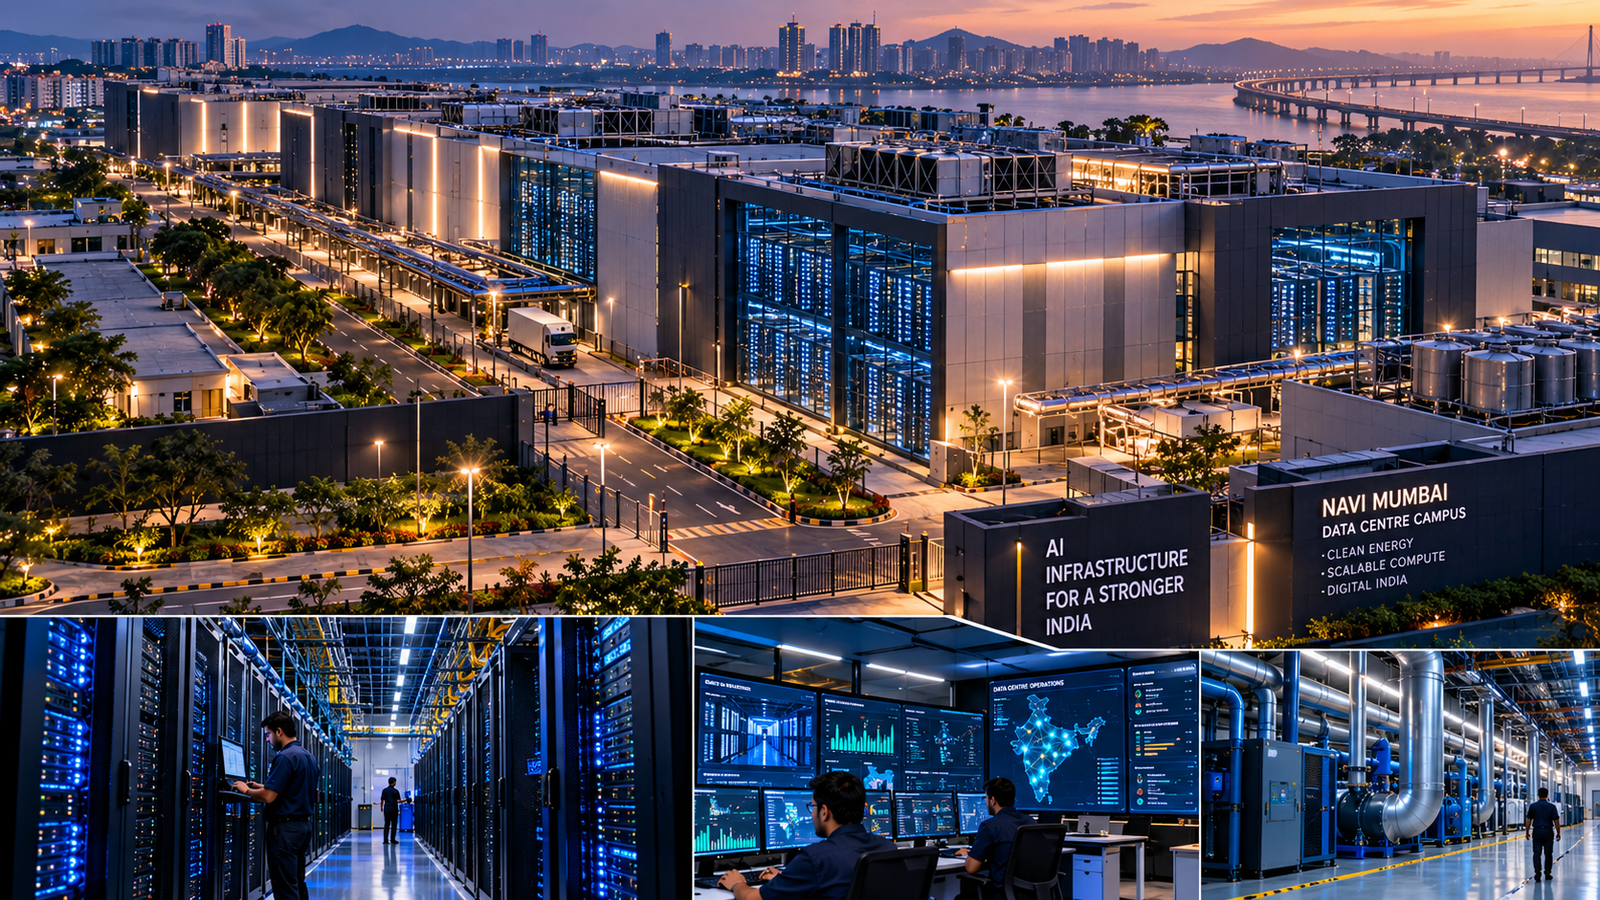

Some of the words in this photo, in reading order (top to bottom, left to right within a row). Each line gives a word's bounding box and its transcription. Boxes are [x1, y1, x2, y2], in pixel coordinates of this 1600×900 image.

[1322, 494, 1366, 518] NAVI
[1372, 483, 1448, 511] MUMBAI
[1322, 522, 1356, 539] DATA
[1360, 514, 1410, 533] CENTRE
[1413, 507, 1466, 525] CAMPUS
[1045, 538, 1064, 558] AI
[1327, 545, 1365, 560] CLEAN
[1369, 538, 1414, 554] ENERGY
[1046, 549, 1189, 584] INFRASTRUCTURE
[1327, 559, 1386, 578] SCALABLE
[1390, 551, 1446, 569] COMPUTE
[1046, 589, 1079, 610] FOR
[1083, 587, 1095, 605] A
[1099, 575, 1184, 603] STRONGER
[1327, 579, 1372, 596] DIGITAL
[1376, 574, 1408, 589] INDIA
[1046, 613, 1093, 636] INDIA
